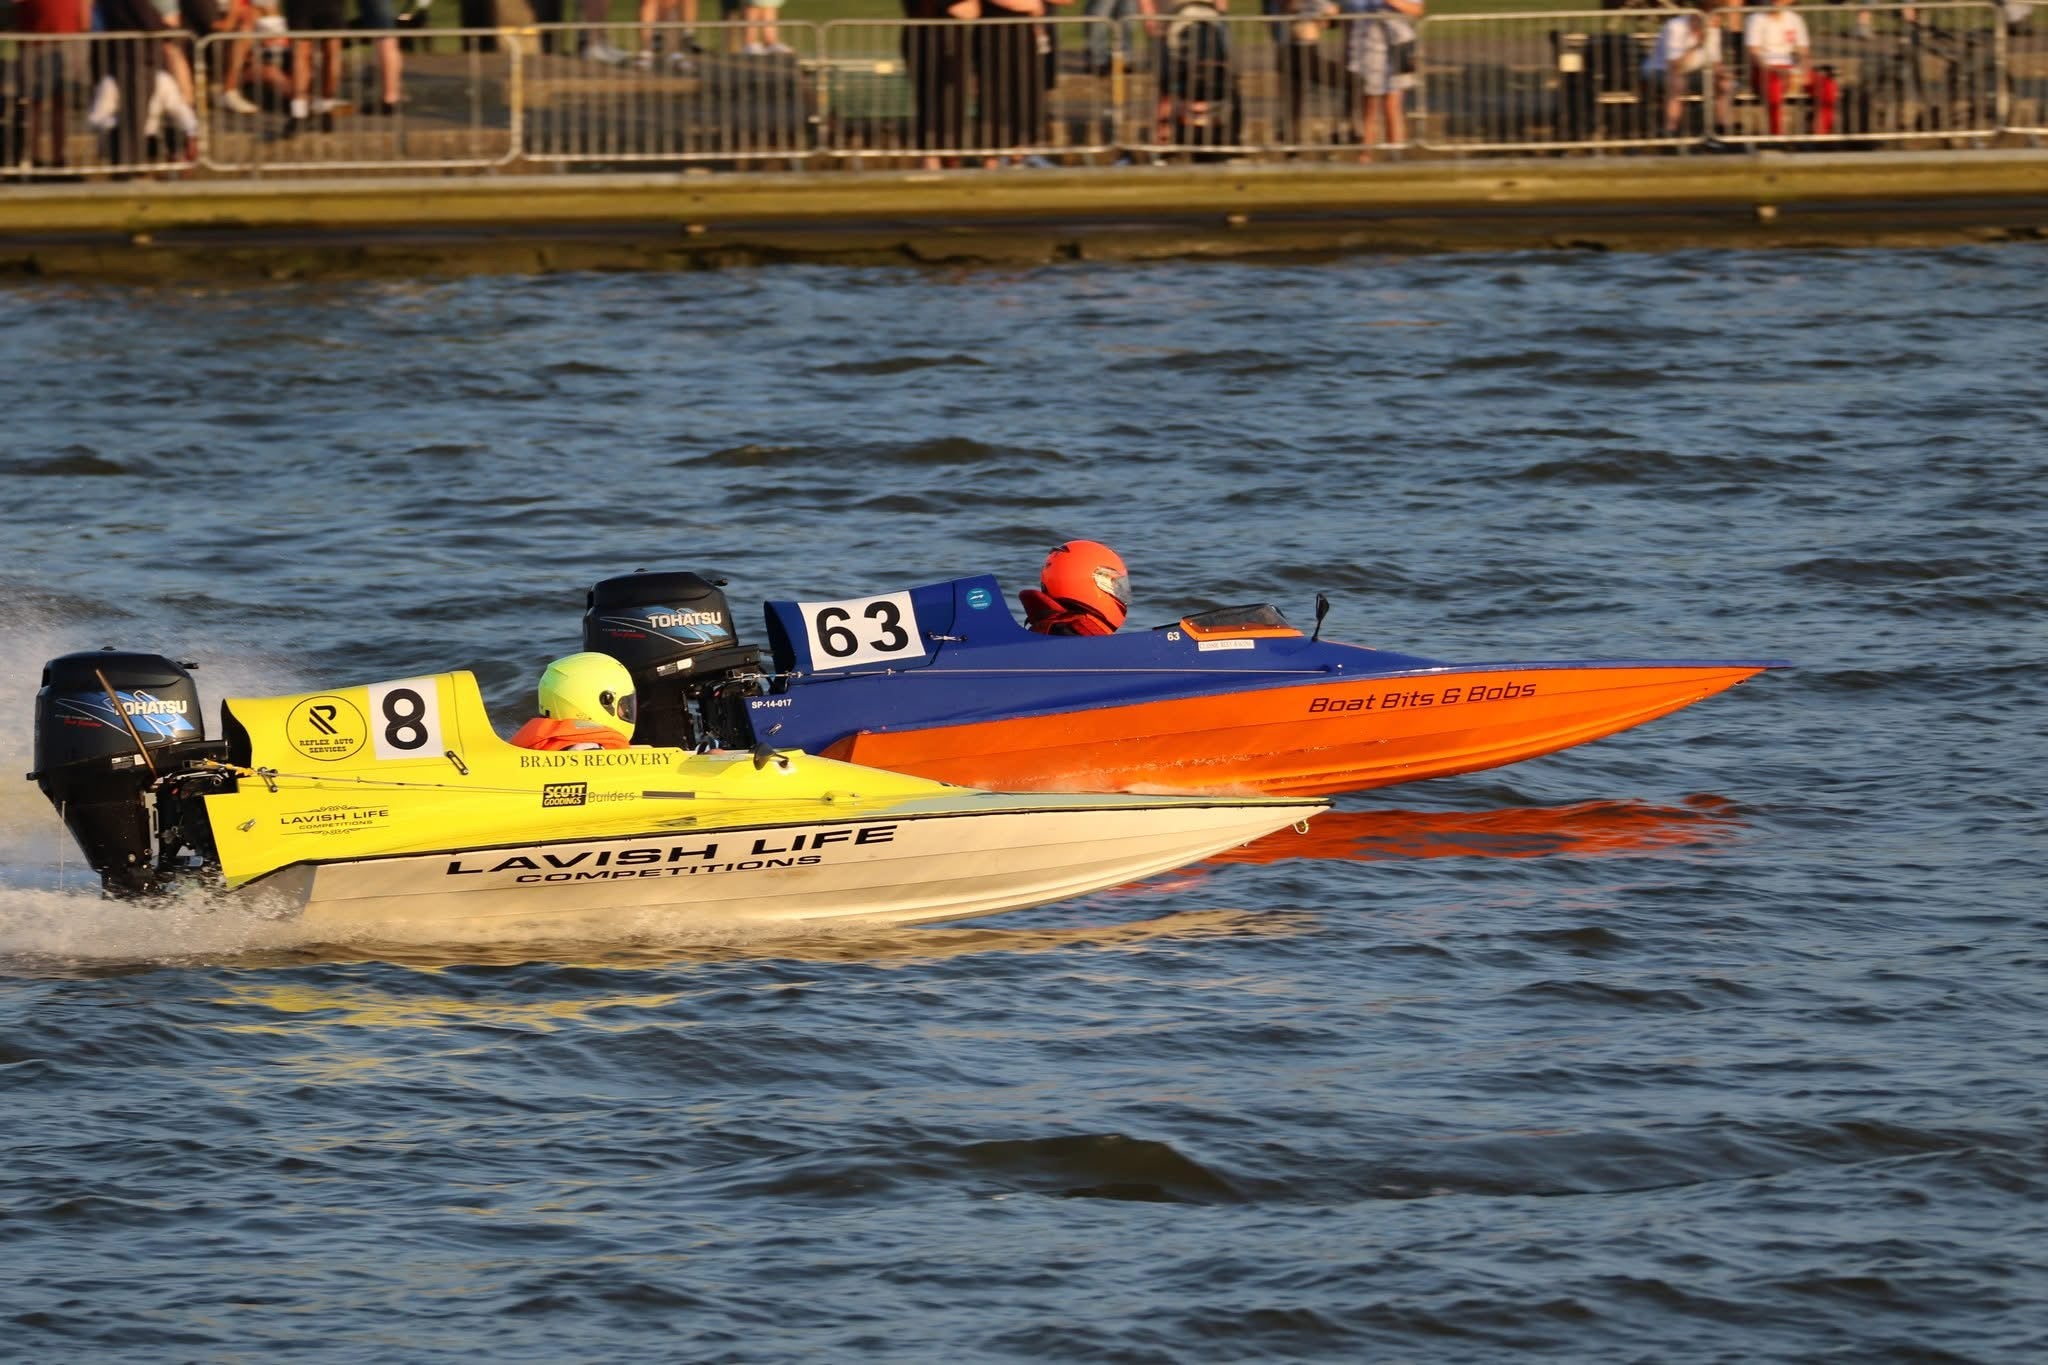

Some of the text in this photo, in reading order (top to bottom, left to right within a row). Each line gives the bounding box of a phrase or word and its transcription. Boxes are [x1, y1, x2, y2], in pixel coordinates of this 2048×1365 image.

[648, 612, 722, 628] TOHATSU
[816, 601, 909, 658] 63
[1167, 632, 1180, 641] 63
[751, 698, 792, 710] SP-14-017
[1309, 681, 1537, 714] Boat Bits & Bobs
[382, 688, 428, 750] 8
[299, 737, 355, 747] REFLEX AUTO
[309, 746, 348, 754] SERVICES
[520, 752, 672, 768] BRAD'S RECOVERY
[544, 784, 586, 799] SCOTT
[588, 790, 635, 804] Builders
[544, 796, 582, 806] GOODINGS
[280, 808, 390, 825] LAVISH LIFE
[298, 819, 376, 831] COMPETITIONS
[446, 824, 899, 876] LAVISH LIFE
[515, 855, 822, 884] COMPETITIONS
